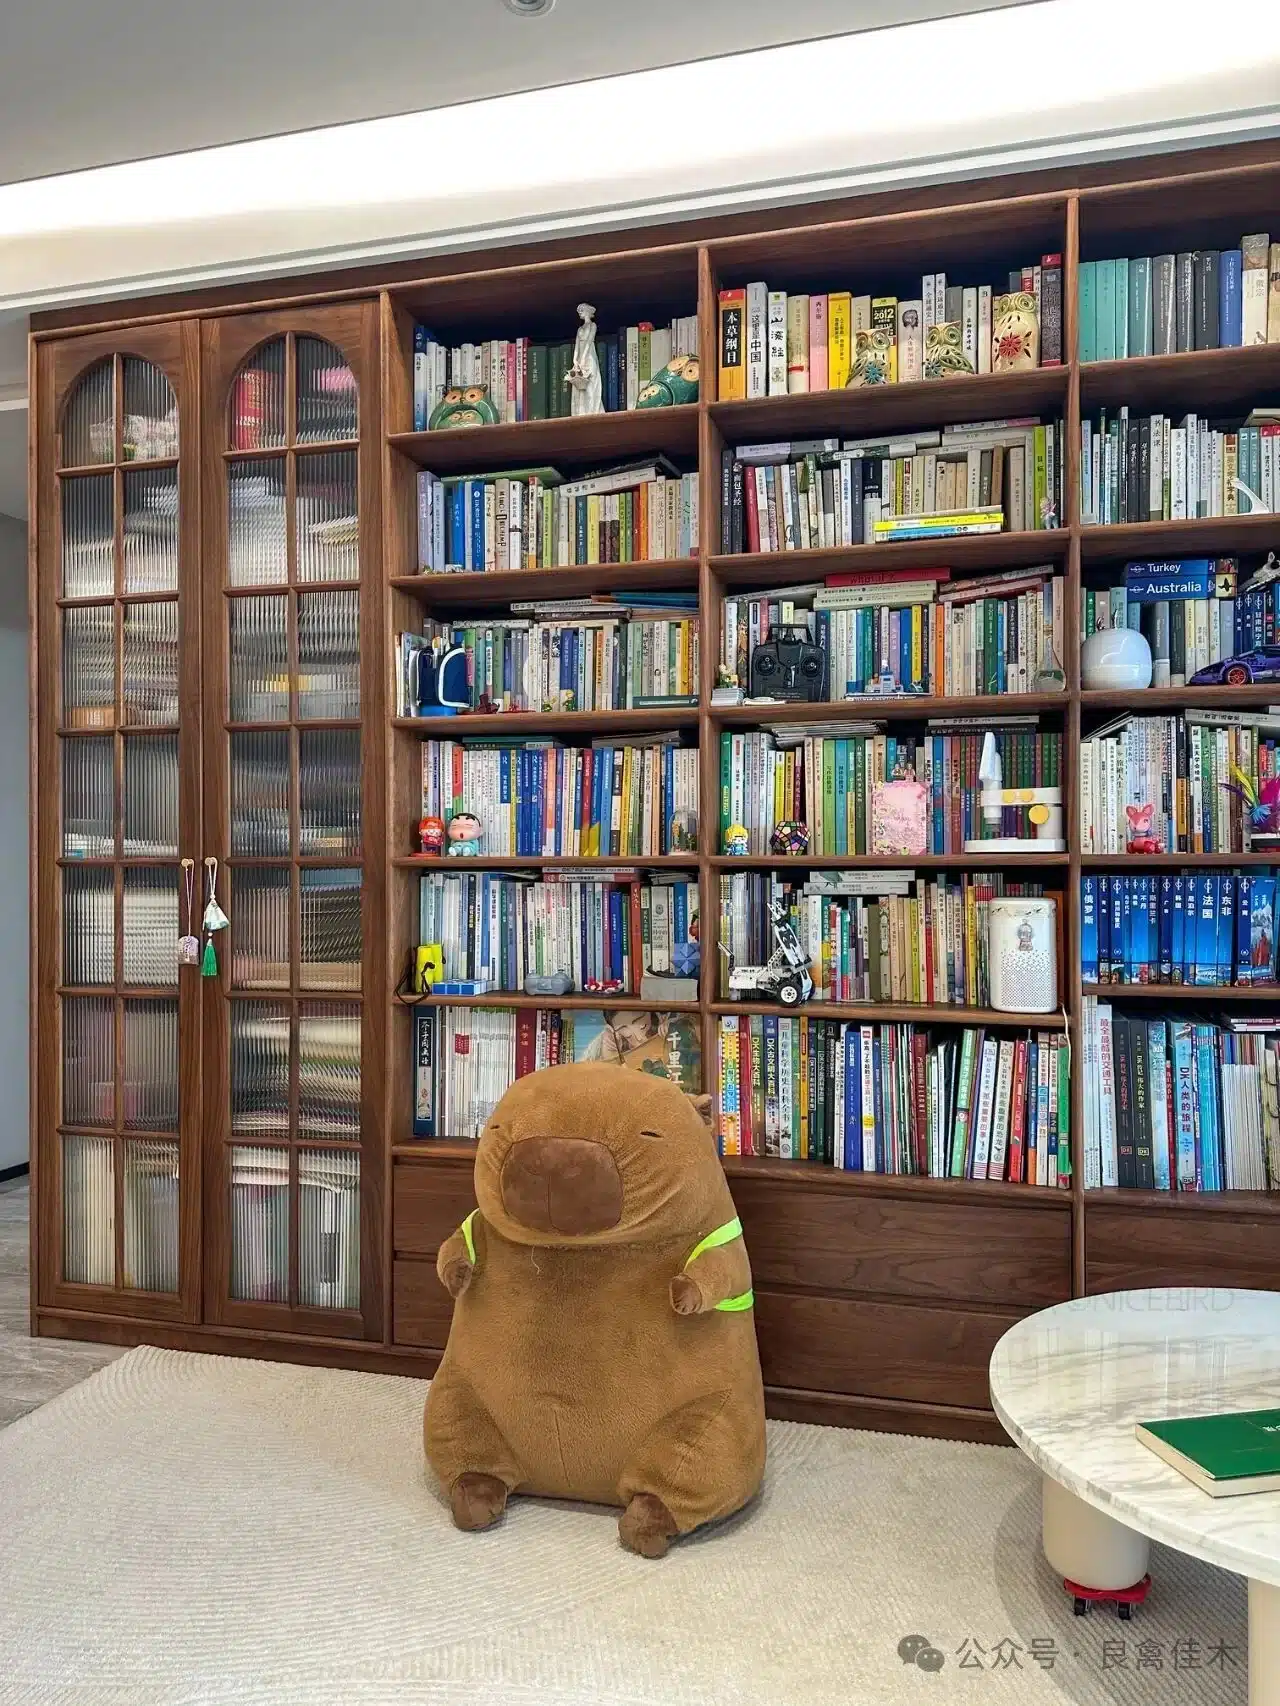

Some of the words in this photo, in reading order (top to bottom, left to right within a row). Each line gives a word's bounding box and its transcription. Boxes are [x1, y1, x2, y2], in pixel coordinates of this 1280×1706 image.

[874, 307, 895, 320] 2012
[726, 311, 738, 364] 本草纲目
[1152, 418, 1162, 447] 书法课
[1147, 563, 1181, 573] Turkey
[1147, 581, 1202, 595] Australia
[1084, 894, 1094, 925] 俄罗斯
[1140, 894, 1147, 910] 不丹
[1149, 894, 1157, 924] 斯里兰卡
[1187, 895, 1195, 916] 尼泊尔
[1202, 895, 1214, 919] 法国
[1221, 895, 1232, 916] 东非
[752, 1037, 760, 1087] DK生物大百科
[766, 1038, 775, 1096] DK古文明大百科
[1099, 1018, 1113, 1095] 最全最酷的交通工具
[1179, 1067, 1191, 1133] DK人类的旅程
